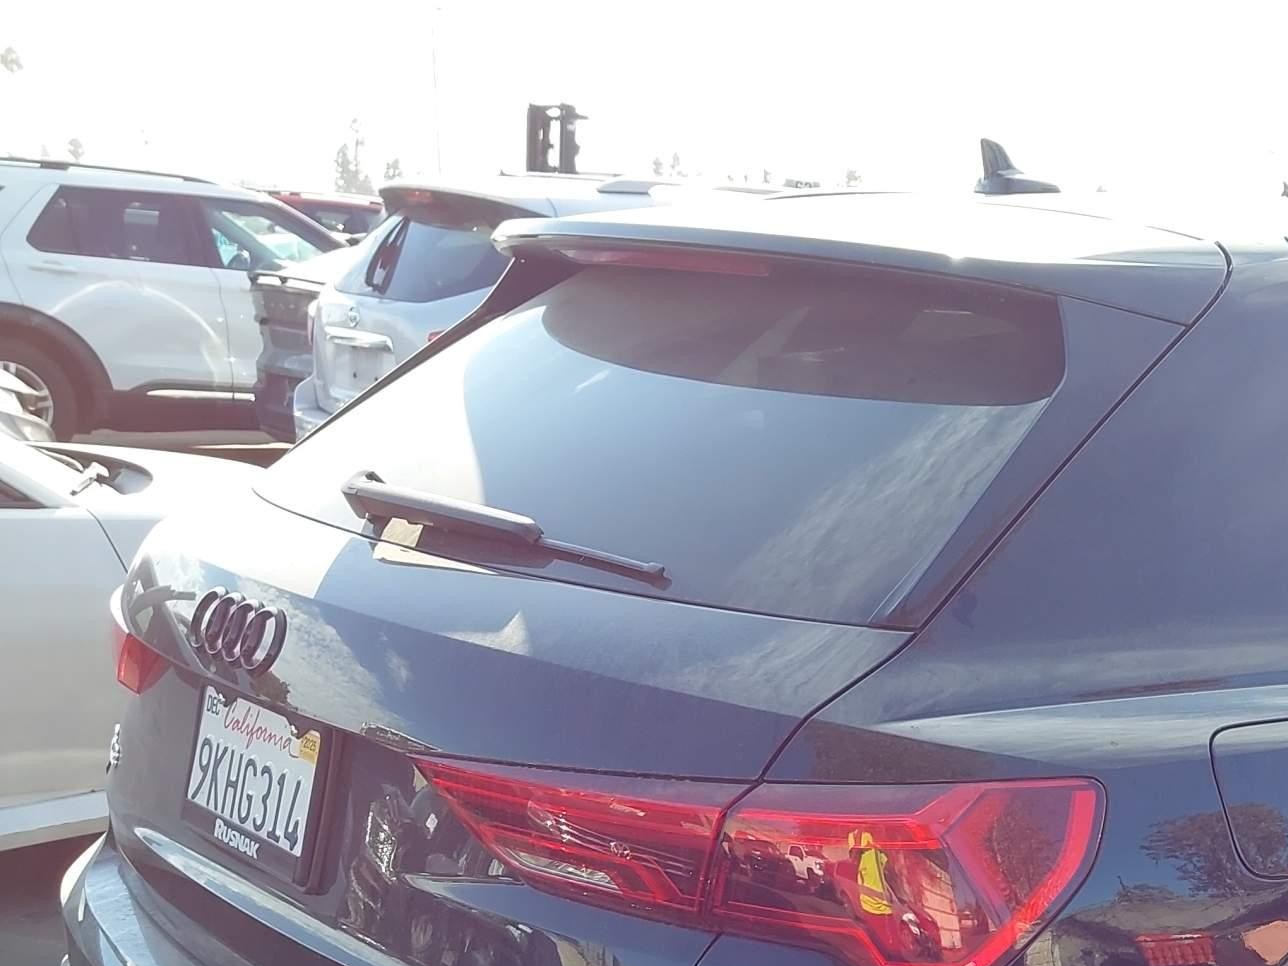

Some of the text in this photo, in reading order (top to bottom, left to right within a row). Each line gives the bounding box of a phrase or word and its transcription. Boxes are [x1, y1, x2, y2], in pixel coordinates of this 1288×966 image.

[206, 694, 221, 716] DEC
[223, 705, 301, 759] California
[191, 737, 302, 852] 9KHG314
[213, 819, 260, 860] RUSNAK
